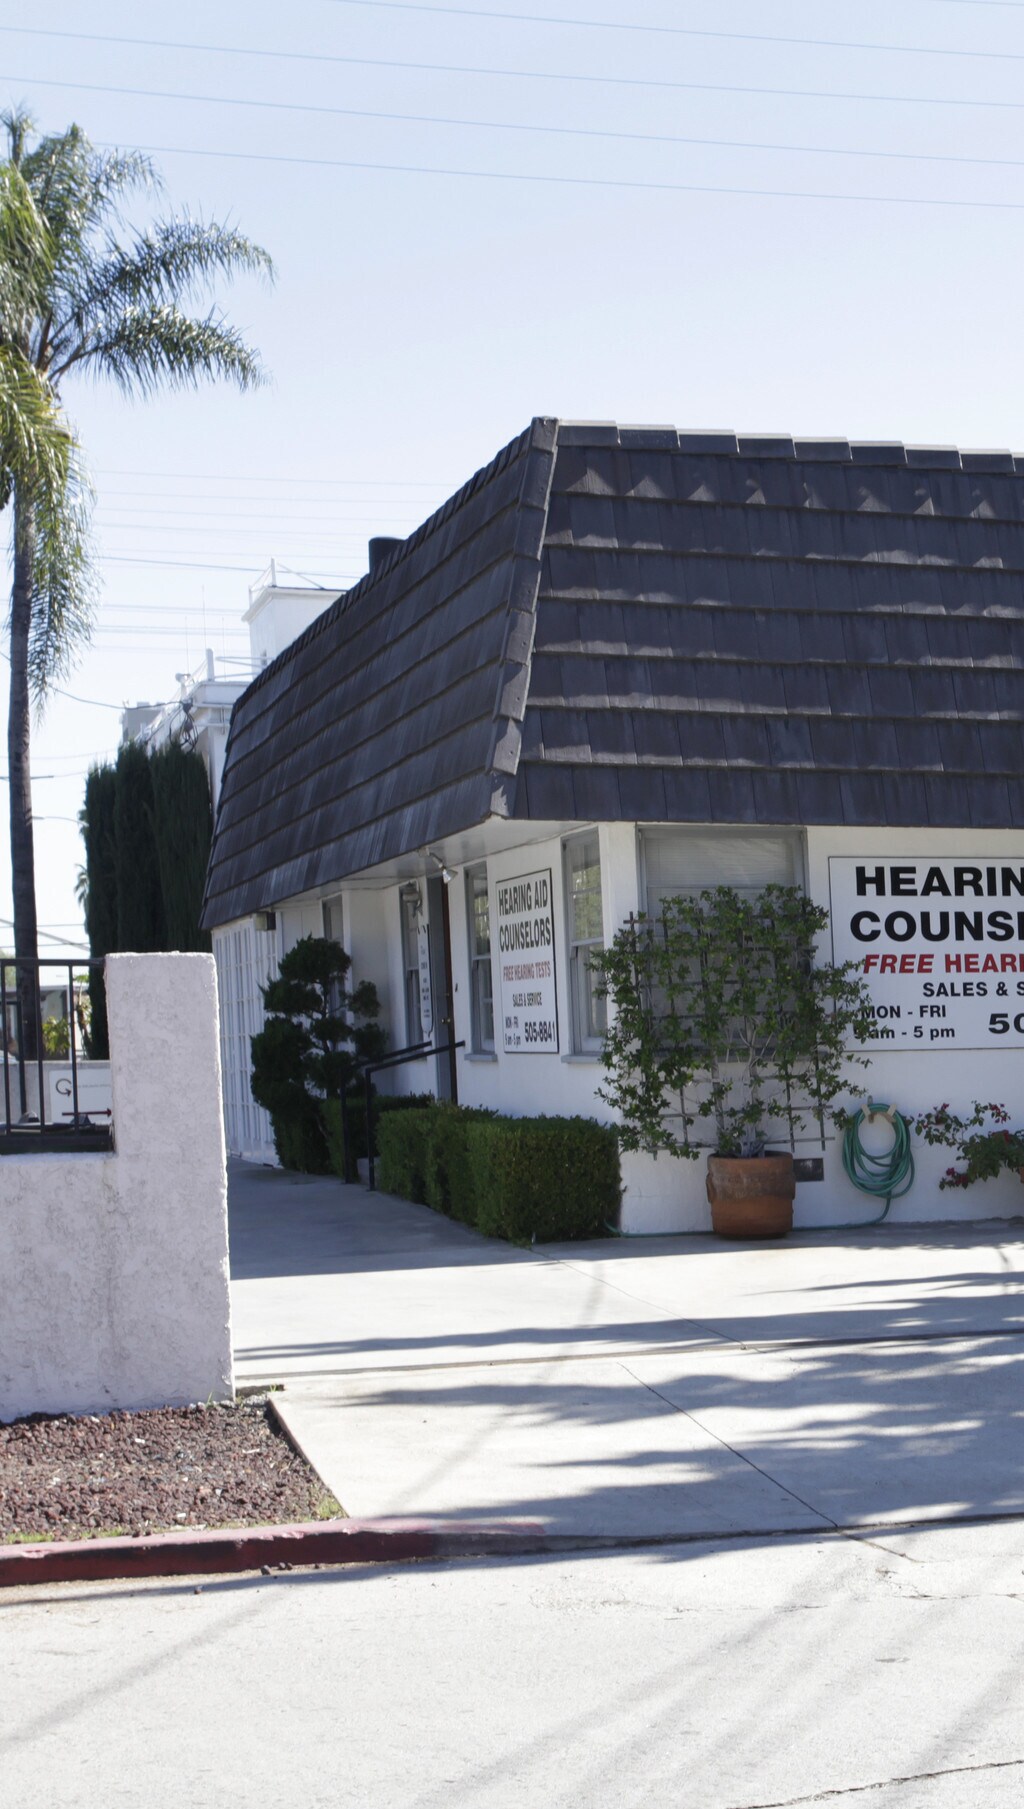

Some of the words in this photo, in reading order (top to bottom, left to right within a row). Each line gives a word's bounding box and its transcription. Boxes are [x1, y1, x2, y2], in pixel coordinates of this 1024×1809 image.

[499, 882, 532, 916] HEARING
[534, 879, 548, 909] AID
[499, 916, 551, 953] COUNSELORS
[503, 964, 514, 981] FREE
[535, 960, 551, 979] TESTS
[862, 953, 935, 974] FREE
[922, 981, 988, 998] SALES
[996, 982, 1009, 997] &
[919, 1004, 947, 1018] FRI
[524, 1020, 556, 1043] 505-8841
[913, 1025, 924, 1039] 5
[930, 1027, 955, 1041] pm
